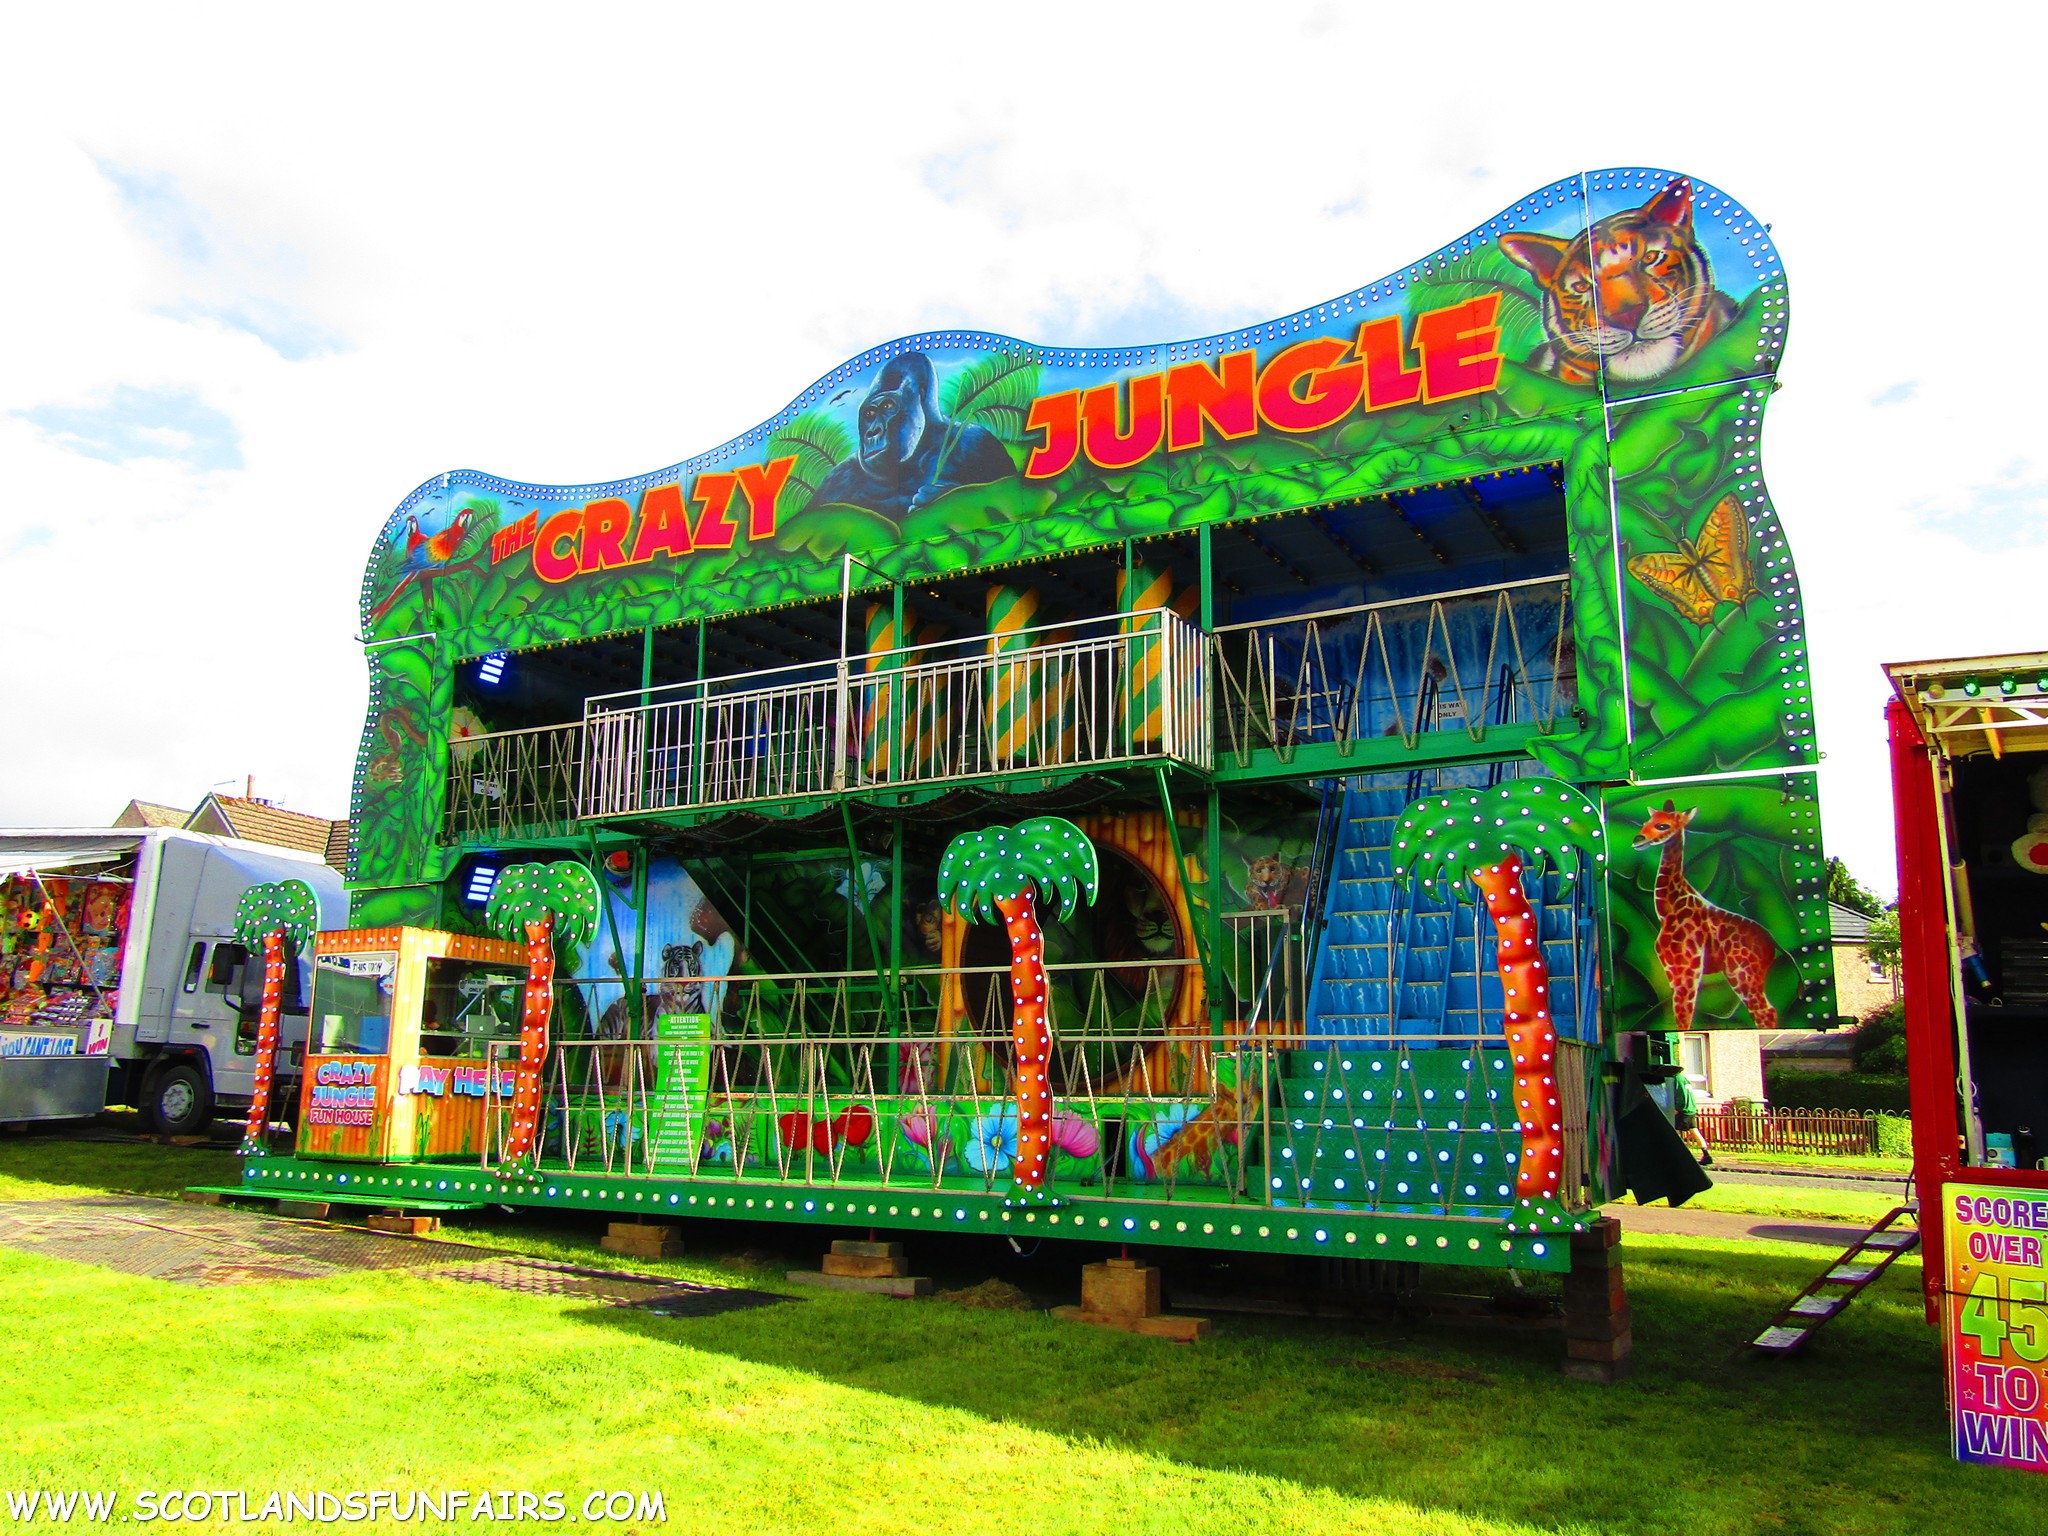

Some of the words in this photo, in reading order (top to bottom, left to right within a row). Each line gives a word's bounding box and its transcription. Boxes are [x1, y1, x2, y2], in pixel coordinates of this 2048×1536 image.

[491, 508, 539, 565] THE
[532, 454, 799, 583] CRAZY
[1025, 291, 1505, 479] JUNGLE
[1, 1037, 23, 1055] YOU
[88, 1037, 109, 1054] WIN
[317, 1061, 377, 1085] CRAZY
[453, 1066, 517, 1097] HERE
[311, 1085, 377, 1108] JUNGLE
[310, 1108, 334, 1124] FUN
[335, 1108, 374, 1126] HOUSE
[1955, 1193, 2048, 1231] SCORE
[1967, 1231, 2044, 1268] OVER
[1960, 1272, 2048, 1361] 45
[1974, 1361, 2040, 1413] TO
[1961, 1409, 2048, 1462] WIN
